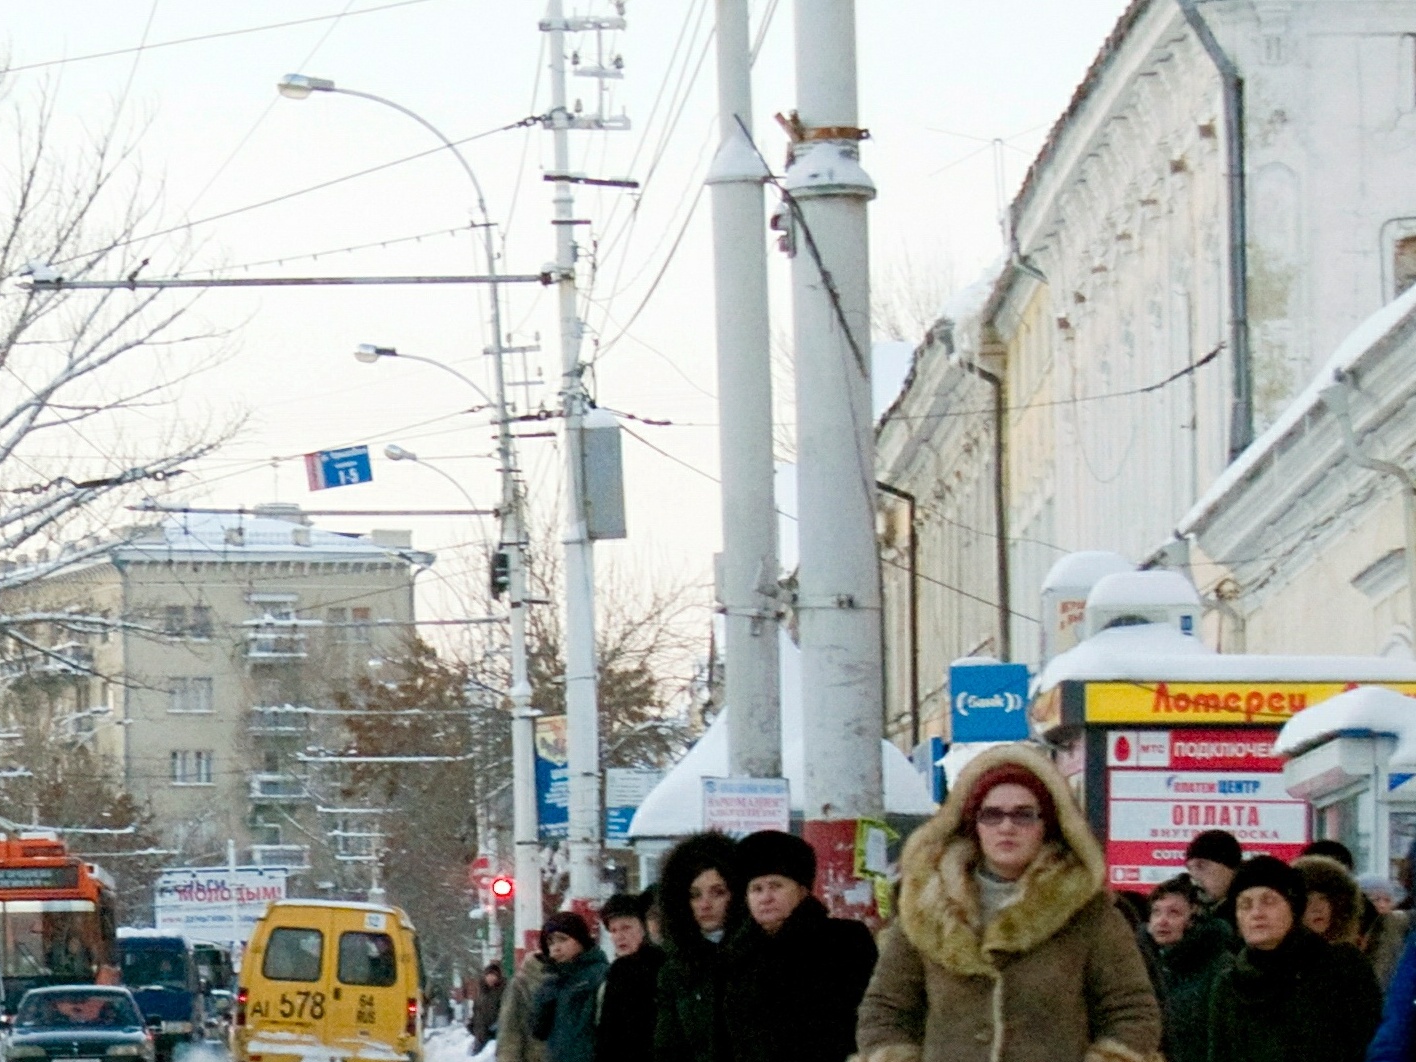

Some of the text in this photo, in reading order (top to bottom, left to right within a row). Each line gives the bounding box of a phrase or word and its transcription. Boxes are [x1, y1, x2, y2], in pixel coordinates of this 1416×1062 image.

[1174, 741, 1274, 759] ПОДКЛЮЧЕ
[1172, 805, 1260, 826] ОПЛАТА
[279, 991, 325, 1019] 578
